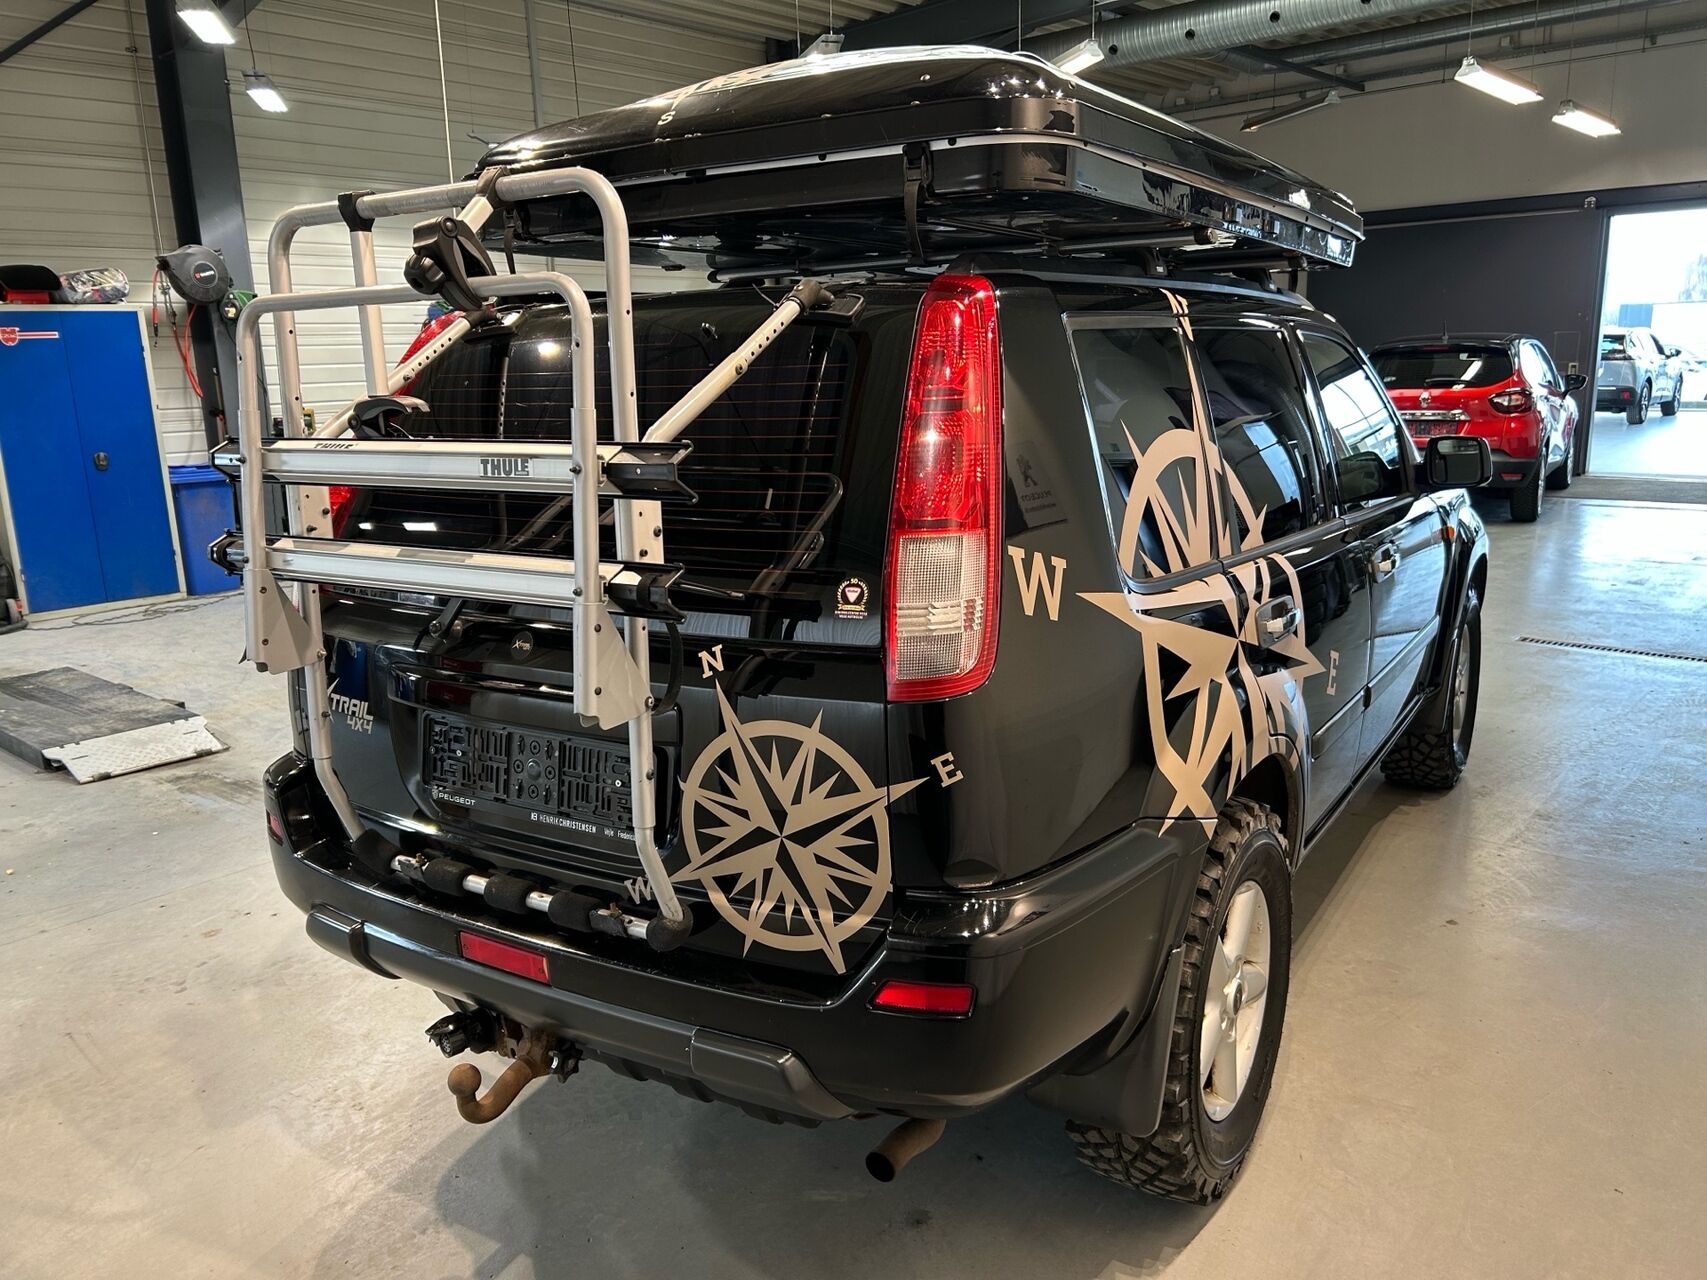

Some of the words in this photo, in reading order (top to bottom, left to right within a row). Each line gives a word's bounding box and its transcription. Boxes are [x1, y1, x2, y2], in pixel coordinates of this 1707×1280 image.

[657, 110, 676, 126] S
[480, 458, 530, 476] THULE
[1007, 544, 1067, 621] W
[697, 643, 725, 679] N
[1326, 649, 1340, 696] E
[930, 751, 964, 788] E
[438, 792, 476, 806] PEUGEOT
